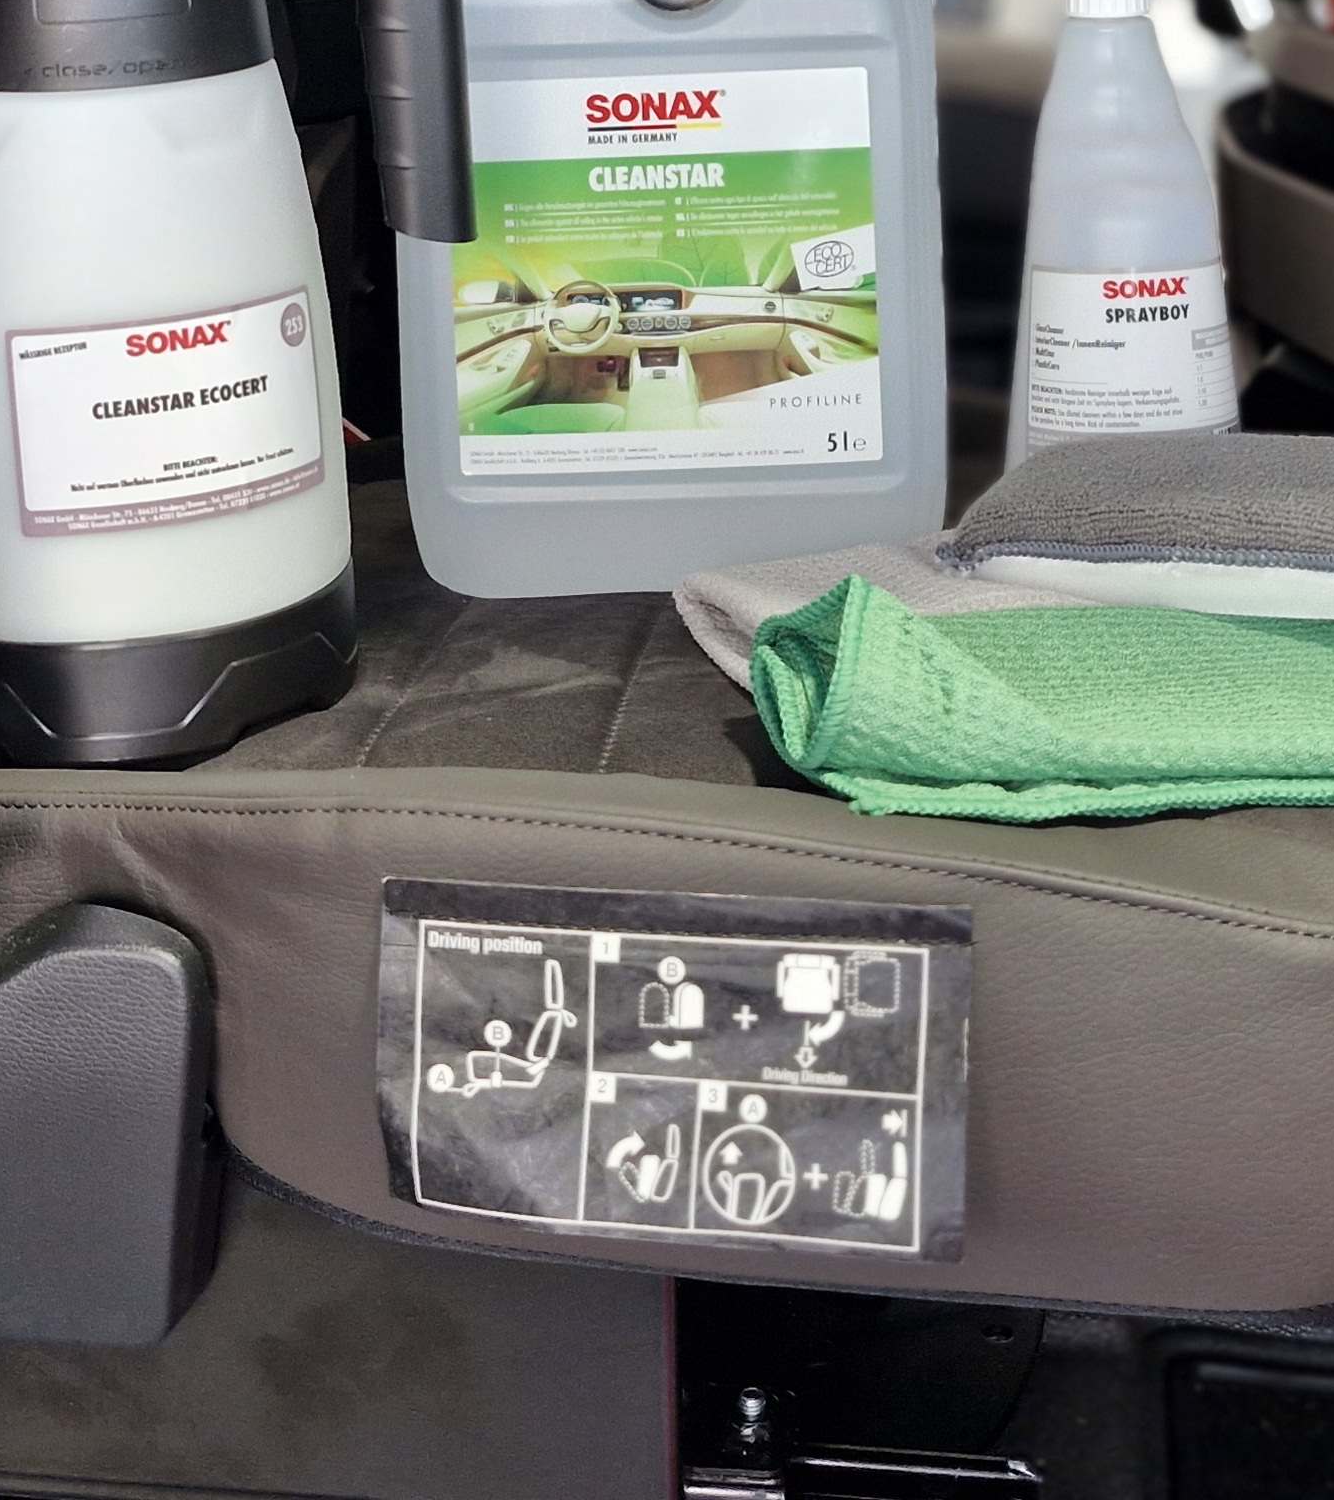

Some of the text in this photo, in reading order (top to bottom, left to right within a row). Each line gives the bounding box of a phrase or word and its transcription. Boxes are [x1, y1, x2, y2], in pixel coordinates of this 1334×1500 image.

[585, 90, 722, 123] SONAX
[588, 132, 678, 144] MADE IN GERMANY
[588, 163, 725, 192] CLEANSTAR
[813, 243, 842, 262] ECO
[815, 254, 850, 275] CERT
[1102, 277, 1188, 300] SONAX
[1105, 304, 1190, 323] SPRAYBOY
[284, 314, 304, 336] 253
[125, 321, 229, 357] SONAX
[92, 375, 269, 420] CLEANSTAR ECOCERT
[769, 393, 863, 408] PROFILINE
[427, 930, 543, 955] Driving position
[492, 1026, 504, 1040] B
[435, 1070, 447, 1085] A
[597, 1078, 608, 1093] 2
[762, 1066, 848, 1087] Driving Direction
[708, 1088, 718, 1103] 3
[747, 1100, 760, 1115] A
